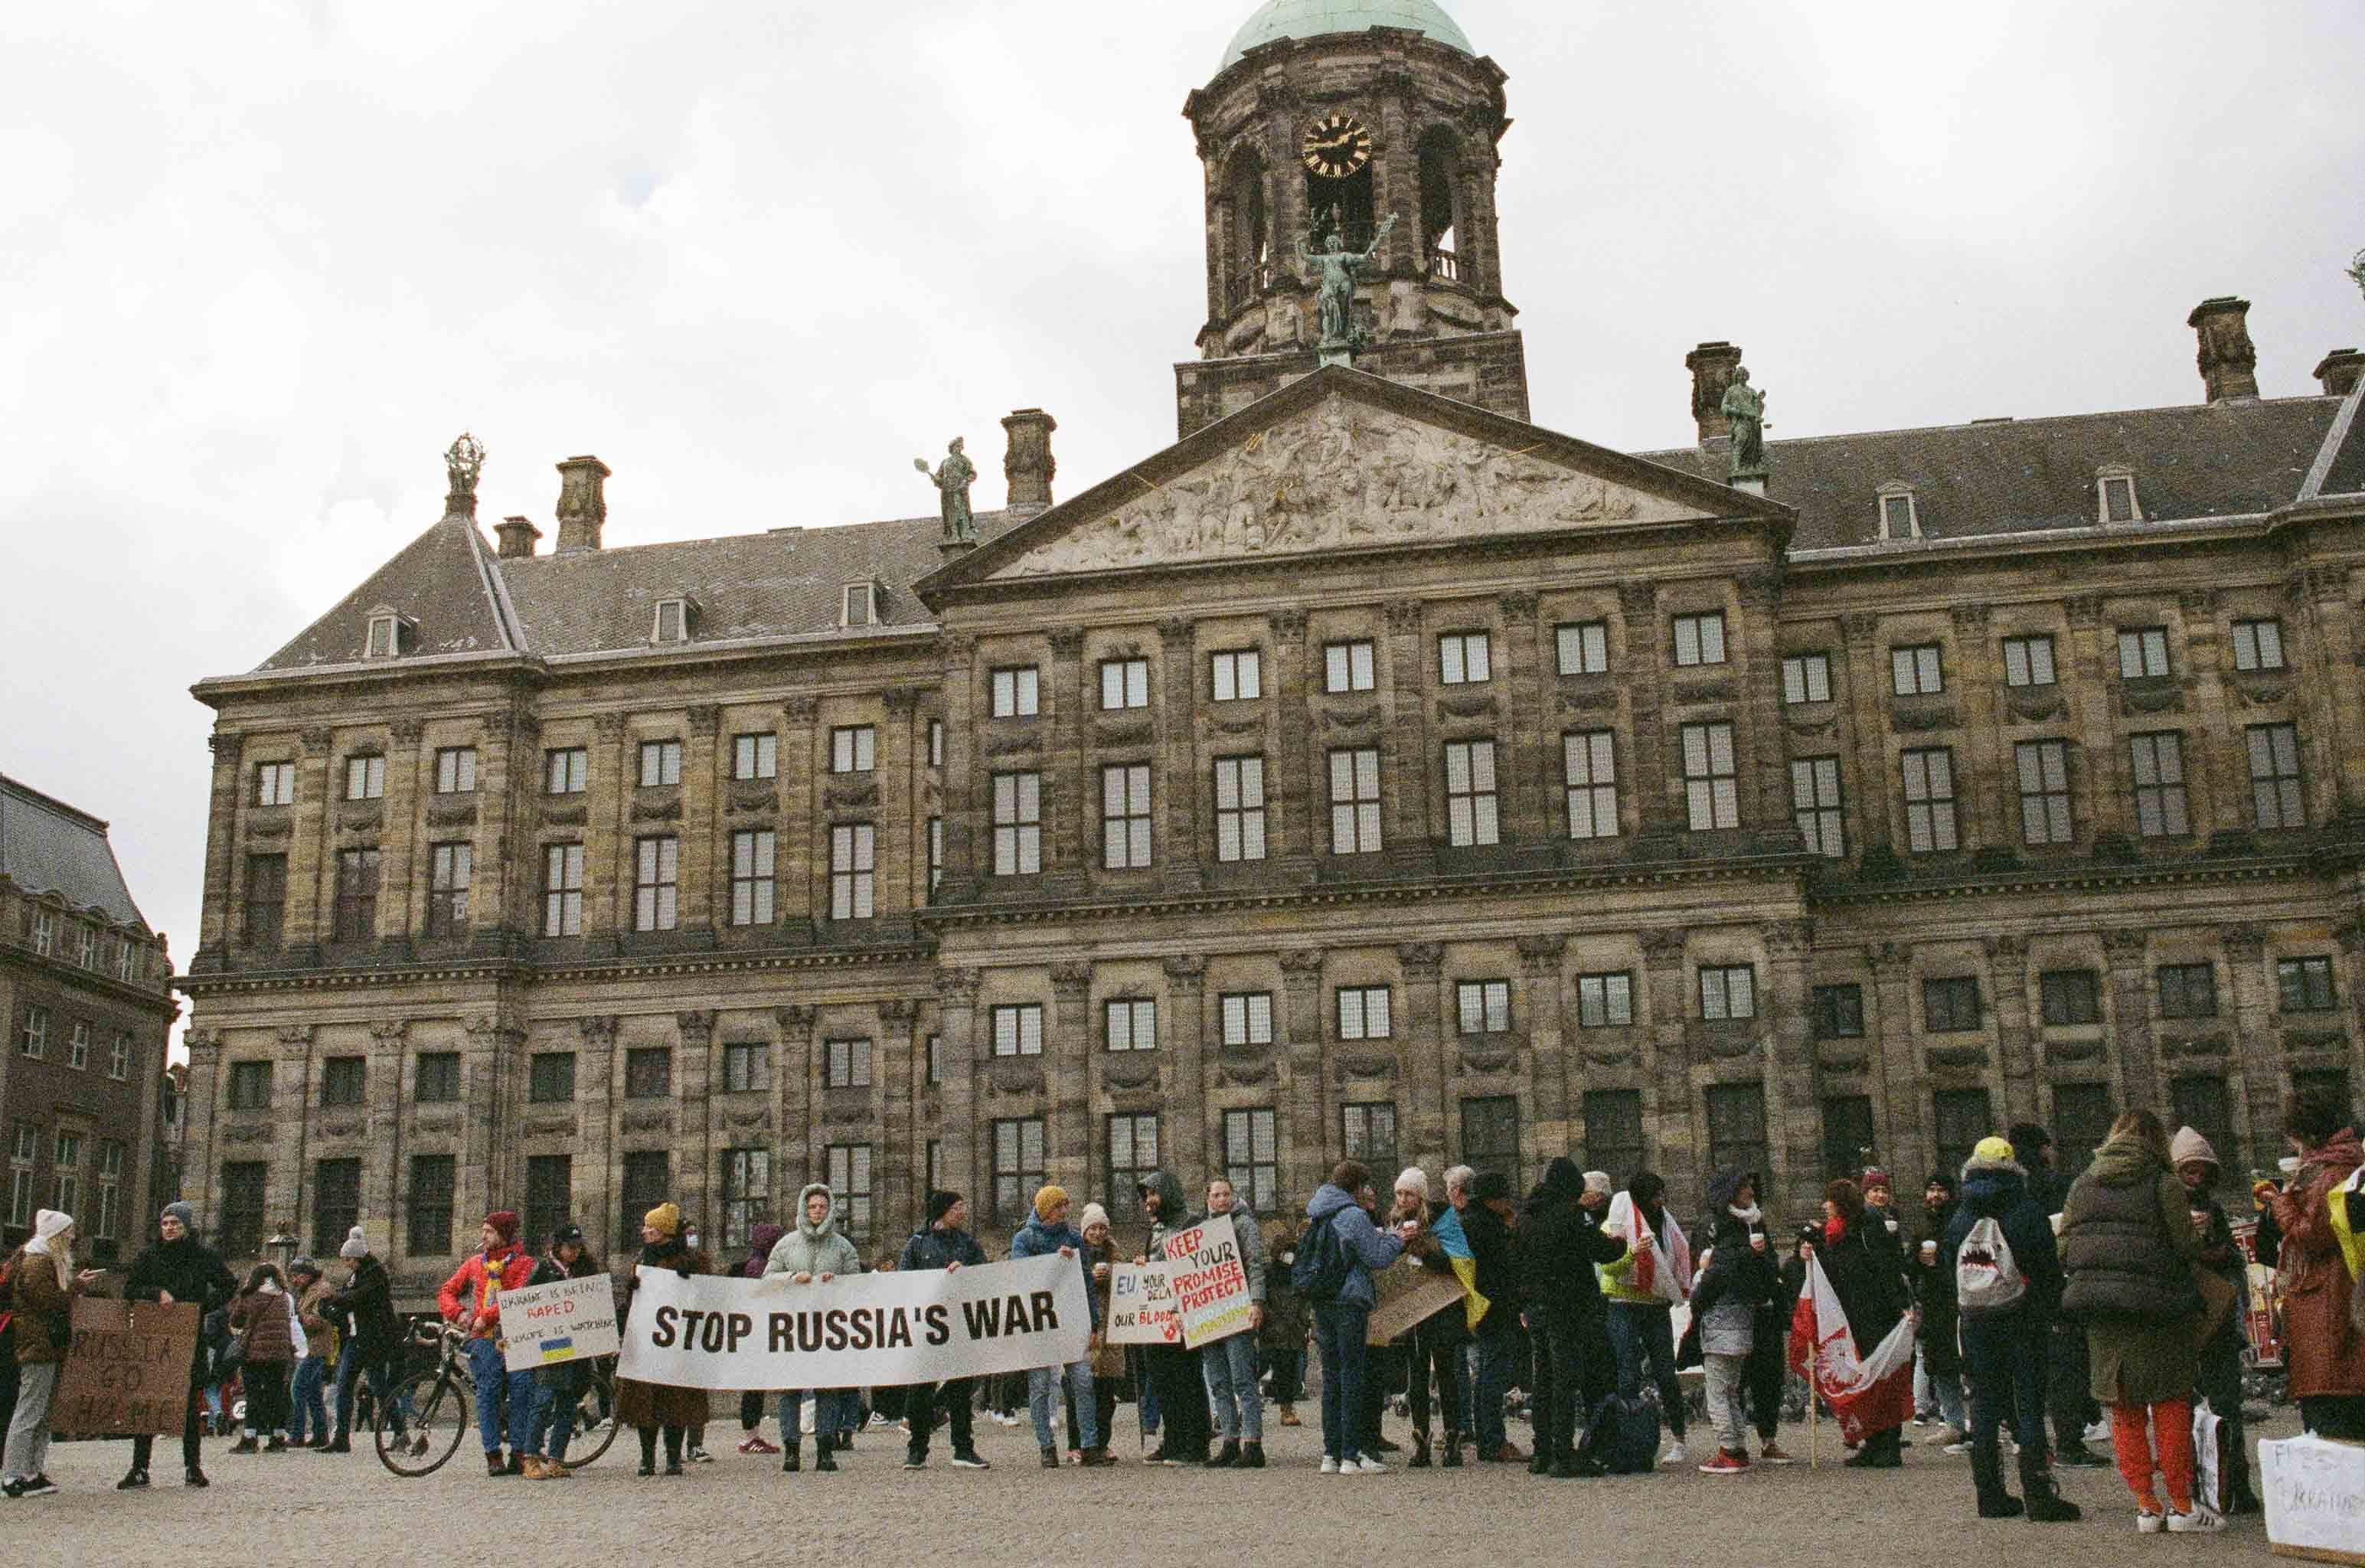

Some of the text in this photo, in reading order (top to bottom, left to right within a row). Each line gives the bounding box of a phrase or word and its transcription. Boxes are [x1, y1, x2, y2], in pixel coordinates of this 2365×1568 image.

[1165, 1228, 1204, 1261] KEEP
[1190, 1241, 1236, 1269] YOUR
[1173, 1260, 1242, 1295] PROMISE
[1181, 1274, 1243, 1313] PROTECT
[526, 1300, 574, 1318] RAPED
[652, 1290, 1059, 1353] STOP RUSSIA'S WAR
[1115, 1313, 1135, 1327] OUR
[72, 1329, 171, 1364] RUSSIA
[100, 1364, 142, 1392] GO
[73, 1394, 175, 1432] HOME
